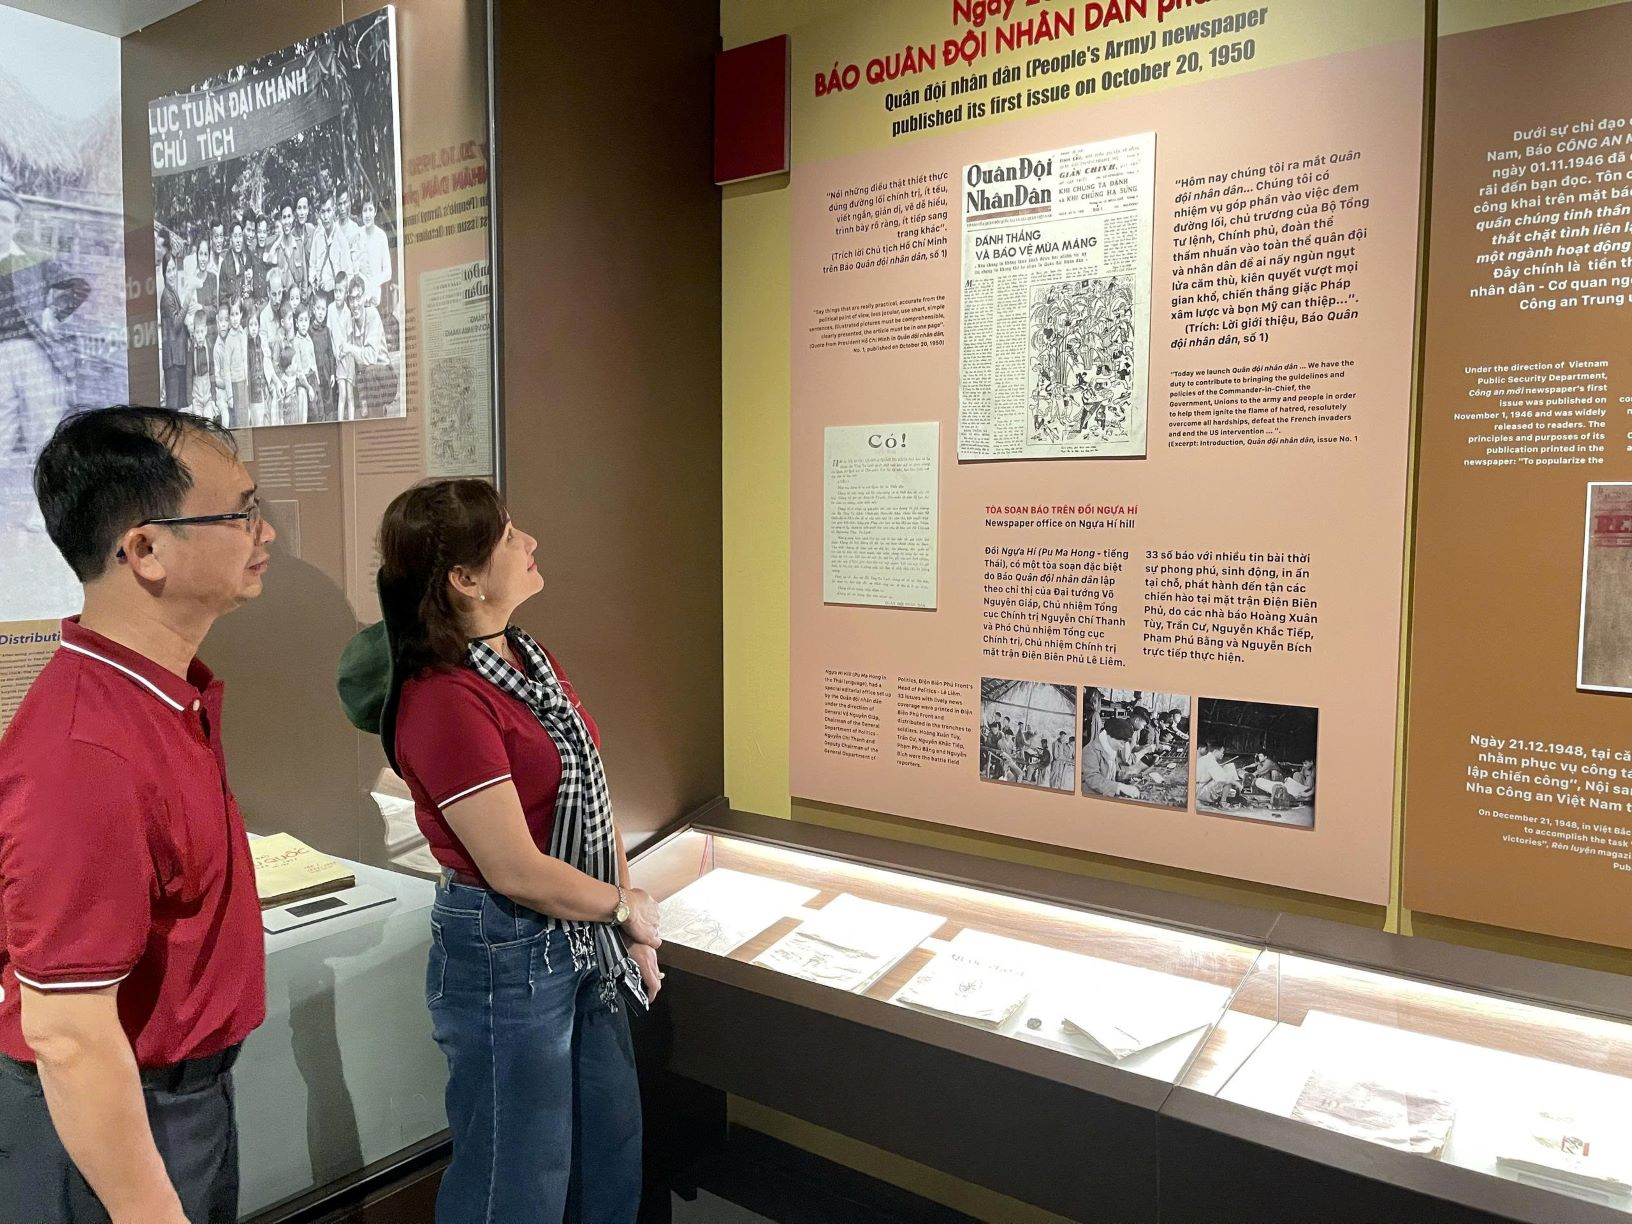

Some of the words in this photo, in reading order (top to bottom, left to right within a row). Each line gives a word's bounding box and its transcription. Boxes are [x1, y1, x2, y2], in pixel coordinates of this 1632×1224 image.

[815, 61, 860, 97] BÁO
[866, 45, 936, 85] QUÂN
[942, 29, 987, 66] ĐỘI
[996, 8, 1075, 53] NHÂN
[885, 89, 920, 112] Quân
[924, 80, 947, 103] đội
[950, 73, 988, 96] nhân
[992, 65, 1021, 86] dân
[1026, 46, 1100, 78] (People's
[1104, 30, 1157, 60] Army)
[1162, 8, 1268, 47] newspaper
[892, 104, 963, 137] published
[967, 102, 986, 120] its
[990, 92, 1023, 115] first
[1026, 84, 1071, 107] issue
[1075, 77, 1096, 97] on
[1101, 61, 1172, 91] October
[1176, 51, 1203, 75] 20,
[1208, 39, 1256, 67] 1950
[148, 104, 179, 140] LỤC
[228, 83, 253, 120] ĐẠI
[255, 67, 308, 110] KHÁNH
[1513, 126, 1547, 141] Dưới
[1550, 124, 1569, 138] sự
[1572, 119, 1594, 134] chỉ
[1598, 118, 1626, 131] đạo
[152, 130, 186, 168] CHỦ
[967, 163, 1018, 188] Quân
[1018, 157, 1052, 181] Đội
[1175, 176, 1206, 188] "Hôm
[1208, 173, 1229, 184] nay
[1230, 166, 1266, 180] chúng
[1268, 161, 1285, 174] tôi
[1287, 162, 1300, 171] ra
[1302, 155, 1326, 168] mắt
[1329, 150, 1361, 164] Quân
[1492, 164, 1527, 179] ngày
[1530, 154, 1604, 173] 01.11.1946
[1607, 151, 1626, 164] đã
[826, 190, 843, 199] "Nói
[844, 187, 869, 197] những
[870, 182, 888, 192] điều
[889, 178, 906, 189] thật
[907, 174, 928, 186] thiết
[928, 172, 949, 182] thực
[966, 190, 1015, 214] Nhân
[1015, 184, 1052, 209] Dân
[897, 229, 919, 238] trang
[920, 223, 948, 235] khác".
[976, 233, 1004, 247] ĐÁNH
[831, 250, 853, 261] (Trích
[854, 248, 864, 257] lời
[865, 245, 881, 256] Chủ
[882, 243, 898, 254] tịch
[899, 240, 911, 251] Hồ
[911, 238, 926, 249] Chí
[927, 236, 948, 247] Minh
[1519, 297, 1556, 311] Công
[1560, 298, 1578, 307] an
[1581, 294, 1625, 306] Trung
[1185, 321, 1220, 335] (Trích:
[1222, 319, 1239, 330] Lời
[1241, 316, 1262, 331] giới
[1264, 314, 1298, 327] thiệu,
[1301, 311, 1324, 323] Báo
[1327, 308, 1359, 321] Quân
[1170, 370, 1195, 378] "Today
[1232, 366, 1251, 374] Quân
[1251, 365, 1264, 373] đội
[1264, 363, 1283, 372] nhân
[1284, 362, 1298, 371] dân
[1341, 359, 1355, 367] the
[1464, 366, 1492, 374] Under
[1494, 364, 1509, 373] the
[1510, 362, 1553, 371] direction
[1554, 361, 1565, 369] of
[1568, 360, 1609, 368] Vietnam
[1477, 376, 1506, 385] Public
[1507, 374, 1547, 383] Security
[1548, 372, 1608, 382] Department,
[1454, 412, 1500, 420] November
[1501, 411, 1508, 420] 1,
[1510, 410, 1533, 418] 1946
[1534, 409, 1553, 418] and
[1574, 408, 1607, 417] widely
[868, 433, 906, 448] Có!
[985, 505, 1003, 514] TÒA
[1004, 506, 1029, 515] SOẠN
[1030, 505, 1050, 514] BÁO
[1051, 504, 1076, 514] TRÊN
[1077, 504, 1095, 515] ĐỒI
[1096, 505, 1125, 515] NGỰA
[1127, 504, 1138, 515] HÍ
[985, 519, 1035, 529] Newspaper
[1036, 518, 1064, 528] office
[1064, 520, 1077, 528] on
[1079, 519, 1105, 530] Ngựa
[1106, 519, 1118, 528] Hí
[1119, 519, 1135, 529] hill
[1145, 550, 1159, 559] 33
[1160, 550, 1173, 560] số
[1175, 550, 1195, 560] báo
[1196, 550, 1213, 561] với
[1215, 551, 1246, 562] nhiều
[1248, 552, 1264, 562] tin
[1267, 552, 1285, 563] bài
[1287, 553, 1311, 563] thời
[0, 630, 60, 645] Distributi
[1470, 734, 1506, 750] Ngày
[1508, 739, 1587, 759] 21.12.1948,
[1591, 748, 1611, 761] tại
[1614, 750, 1632, 762] că
[1478, 808, 1491, 816] On
[1492, 810, 1539, 823] December
[1540, 817, 1553, 827] 21,
[1554, 819, 1580, 830] 1948,
[1582, 822, 1591, 831] in
[1593, 824, 1612, 834] Việt
